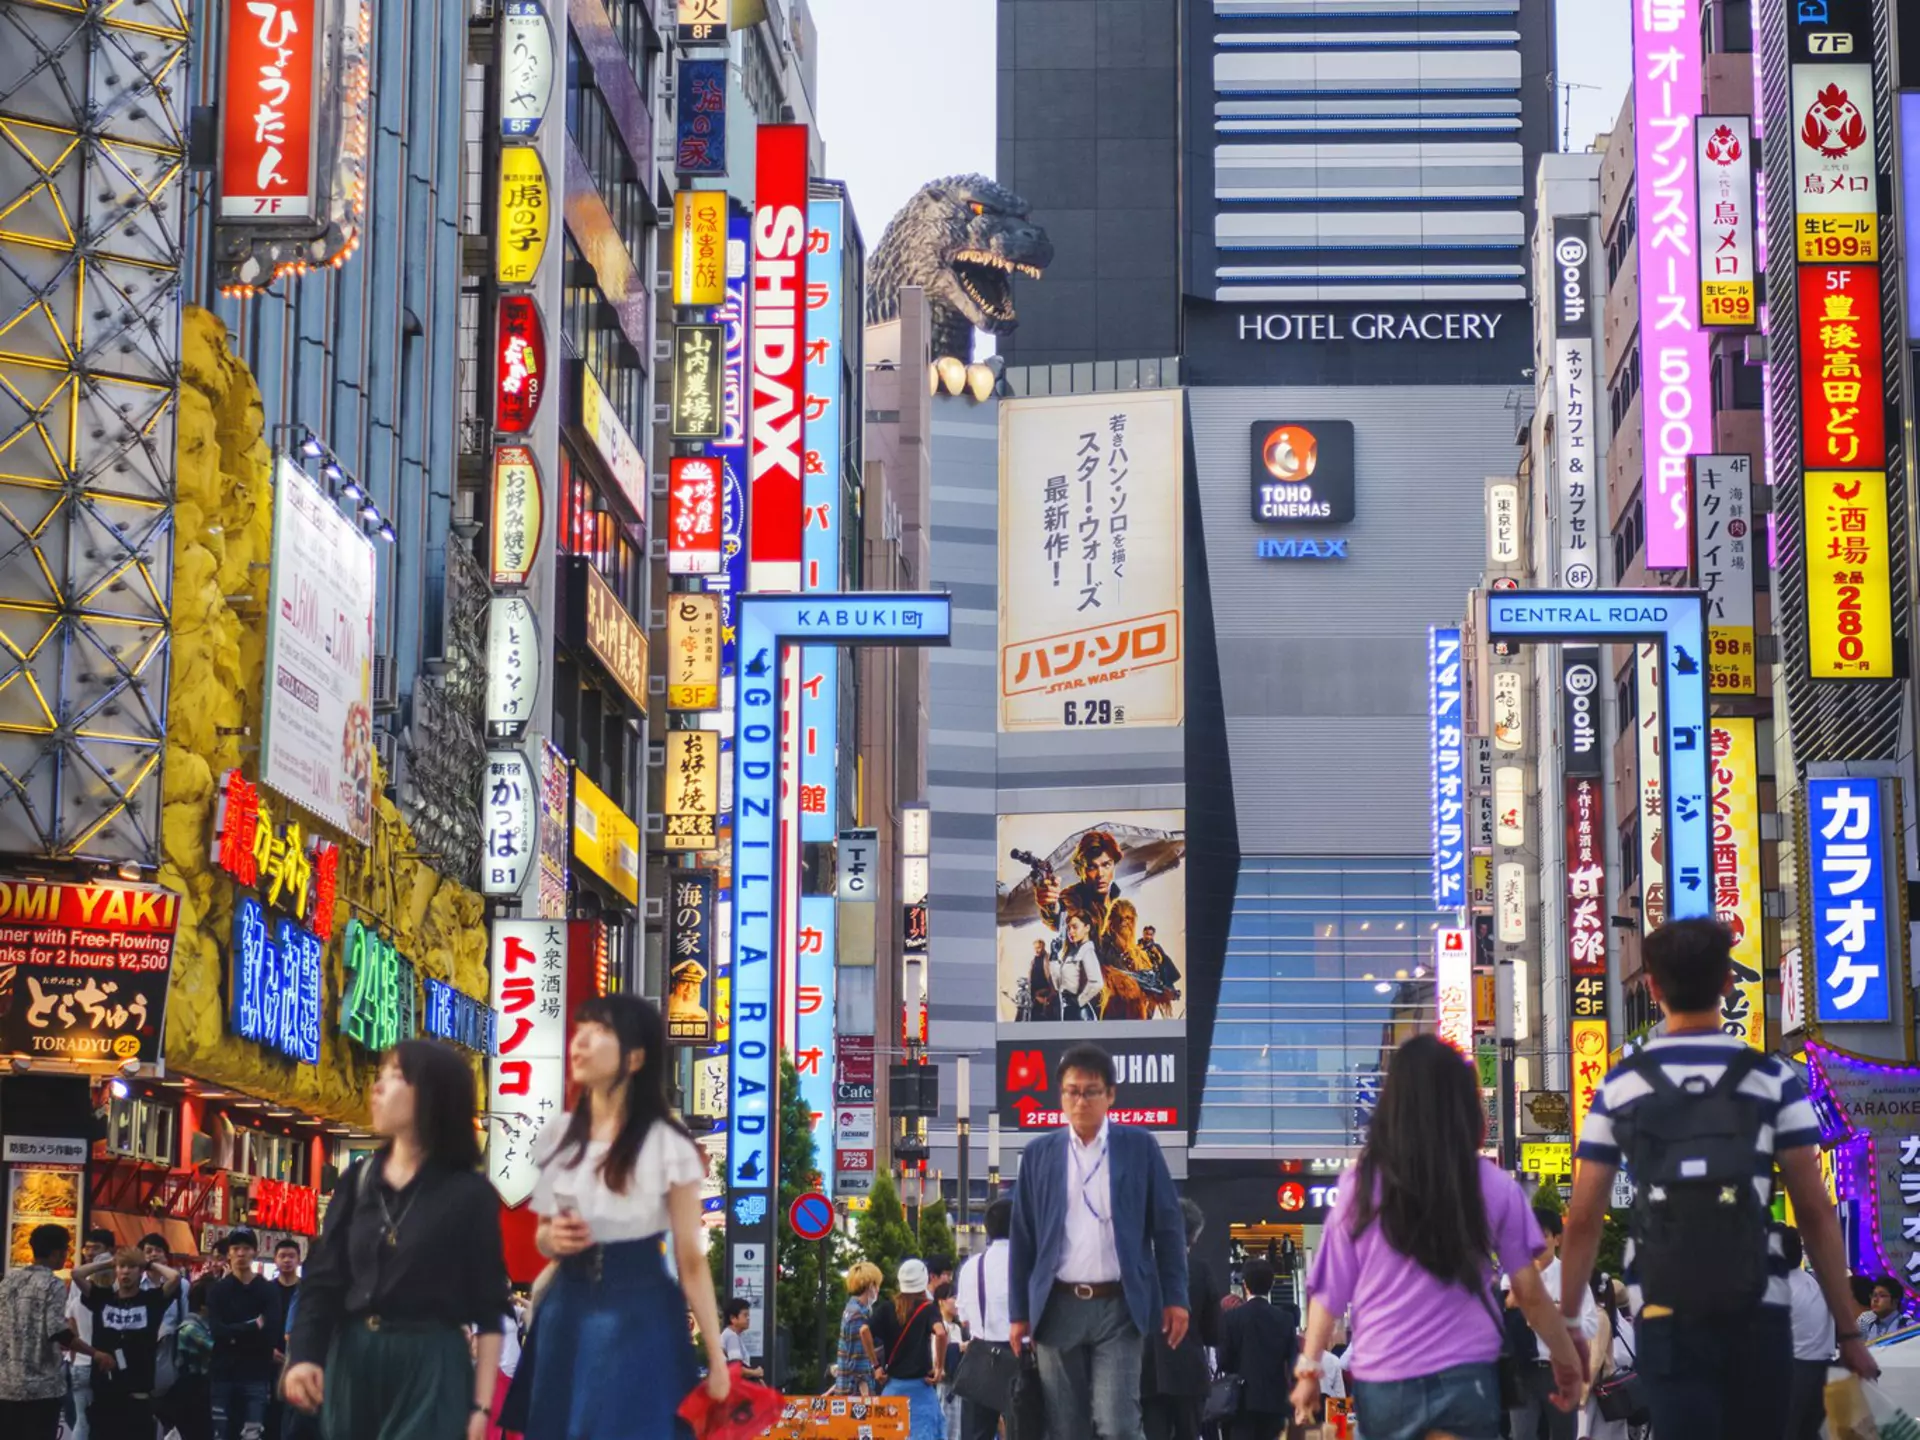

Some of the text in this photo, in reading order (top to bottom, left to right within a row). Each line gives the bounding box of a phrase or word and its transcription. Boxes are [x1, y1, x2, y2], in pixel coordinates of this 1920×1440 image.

[692, 25, 712, 39] 8F
[1813, 35, 1849, 52] 7F
[247, 2, 298, 190] ひょうたん
[510, 118, 531, 133] 5F
[1648, 46, 1692, 332] オープンスペース
[1804, 173, 1869, 194] 鳥メロ
[253, 199, 282, 213] 7F
[505, 184, 542, 252] 虎の子
[1804, 218, 1870, 235] 生ビール
[1815, 236, 1859, 257] 199
[502, 264, 527, 278] 4F
[1826, 271, 1851, 290] 5F
[1706, 286, 1748, 296] 生ビール
[1711, 297, 1750, 314] 199
[1239, 313, 1503, 340] HOTEL GRACERY
[753, 204, 804, 483] SHIDAX
[681, 331, 713, 422] 山内農場
[1819, 294, 1863, 464] 豊後高田どり
[688, 420, 705, 432] 5F
[1566, 349, 1587, 550] ネットカフェ & カプセル
[1730, 459, 1748, 473] 4F
[1261, 486, 1312, 503] TOHO
[504, 469, 526, 570] お好み焼き
[1261, 503, 1332, 517] CINEMAS
[1497, 500, 1512, 556] 東京ビル
[1826, 505, 1871, 565] 酒場
[1257, 539, 1348, 558] IMAX
[494, 572, 522, 583] 2階
[1571, 570, 1589, 584] 8F
[1833, 571, 1864, 584] 全品
[1500, 607, 1669, 623] CENTRAL ROAD
[1837, 585, 1864, 661] 280
[1014, 622, 1167, 685] ハン・ソロ
[1743, 643, 1753, 656] 円
[502, 626, 523, 715] とらそば
[1045, 669, 1129, 694] STAR WARS
[1743, 676, 1753, 688] 円
[681, 687, 706, 704] 3F
[1063, 699, 1112, 727] 6.29
[1565, 663, 1599, 753] Booth
[495, 721, 518, 736] 1F
[490, 762, 521, 776] 新宿
[677, 734, 706, 812] お好み焼
[489, 778, 523, 858] かっぱ
[1673, 725, 1703, 892] ゴジラ
[667, 815, 713, 835] 大阪家
[1577, 781, 1593, 863] 手作り居酒屋
[491, 868, 517, 884] B1
[76, 888, 176, 928] YAKI
[1820, 787, 1880, 1011] カラオケ
[676, 883, 703, 956] 海の家
[1568, 865, 1606, 965] 甘太郎
[33, 930, 67, 945] with
[70, 930, 170, 954] Free-Flowing
[30, 948, 53, 963] for
[56, 949, 67, 964] 2
[69, 951, 114, 967] hours
[119, 953, 168, 971] ¥2,500
[540, 925, 563, 1019] 大衆酒場
[1575, 978, 1603, 996] 4F
[1575, 997, 1603, 1015] 3F
[498, 937, 536, 1097] トラノコ
[32, 1036, 113, 1053] TORADYU
[117, 1039, 137, 1053] 2F
[838, 1084, 873, 1099] Cafe
[9, 1143, 83, 1156] 防犯カメラ作動中
[843, 1157, 868, 1168] 729
